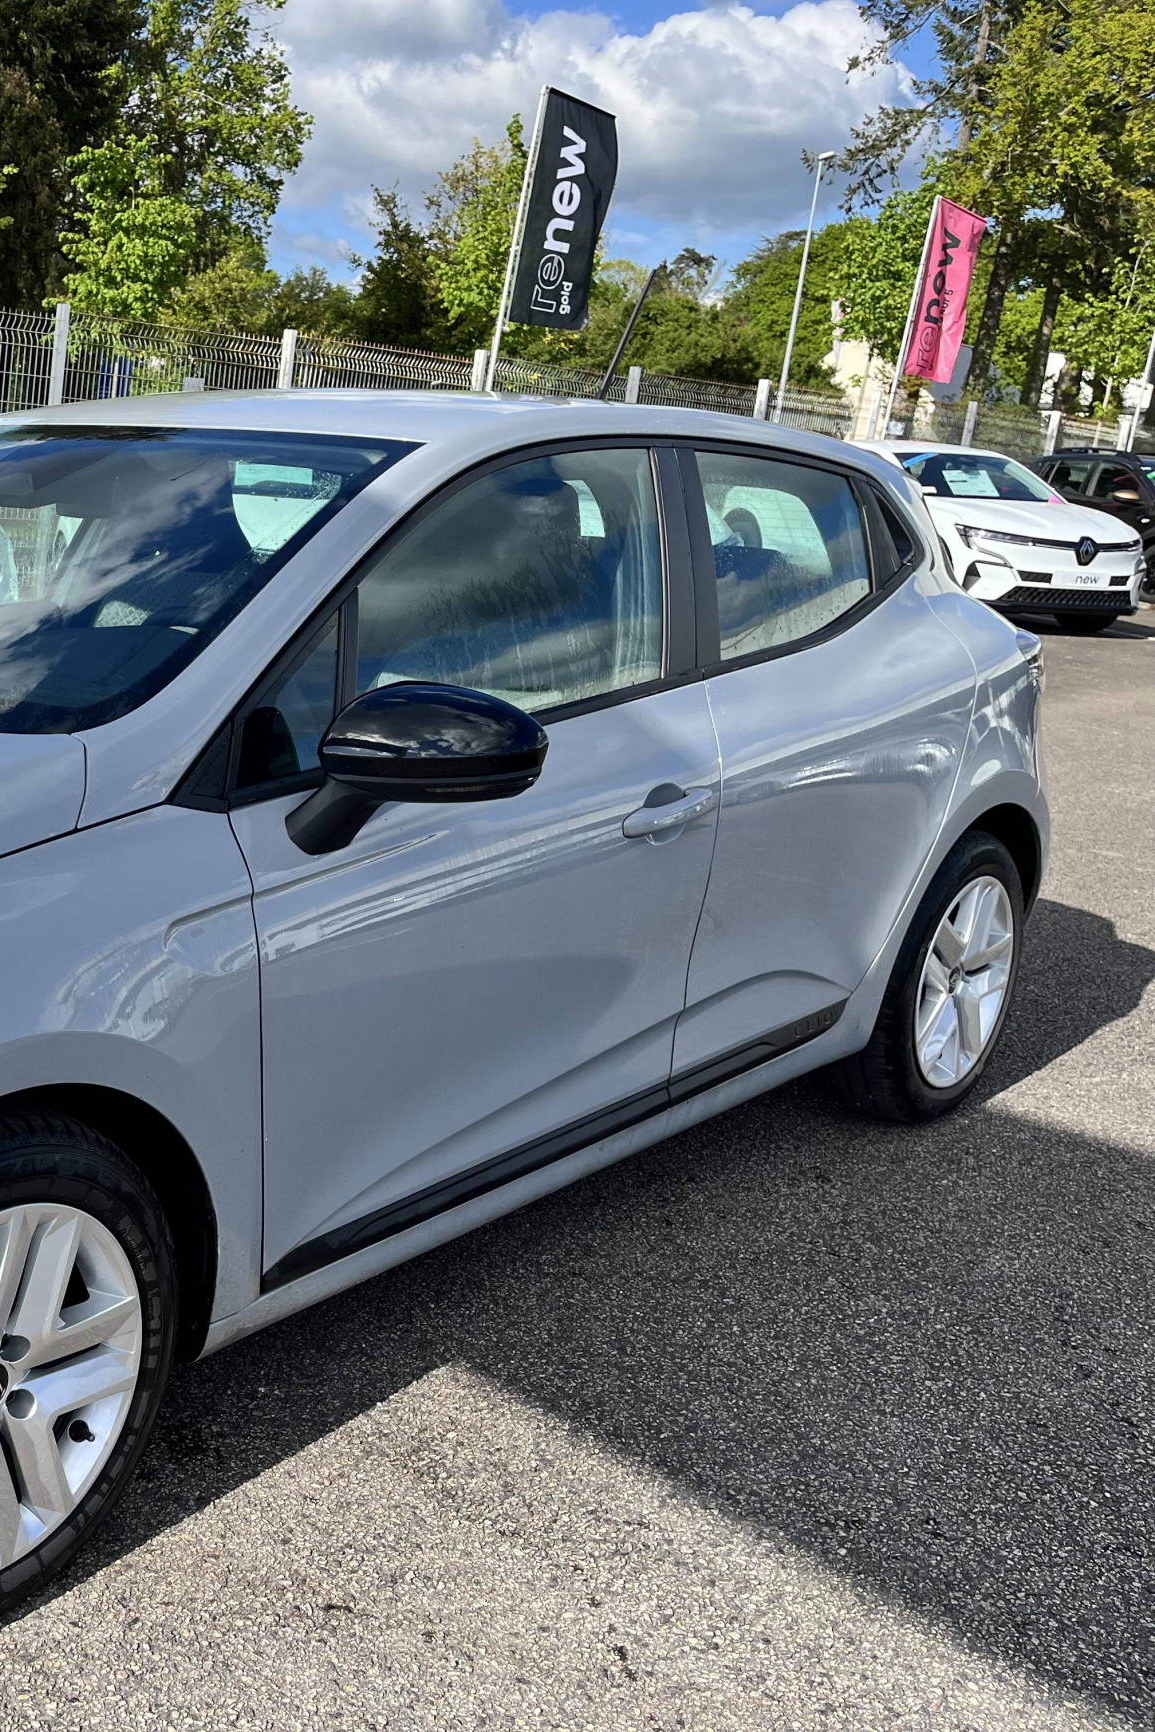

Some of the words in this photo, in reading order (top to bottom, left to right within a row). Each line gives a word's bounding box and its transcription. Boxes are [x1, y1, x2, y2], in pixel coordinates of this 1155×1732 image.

[530, 124, 587, 314] renew
[557, 280, 574, 316] gold
[794, 1009, 834, 1039] CLIO
